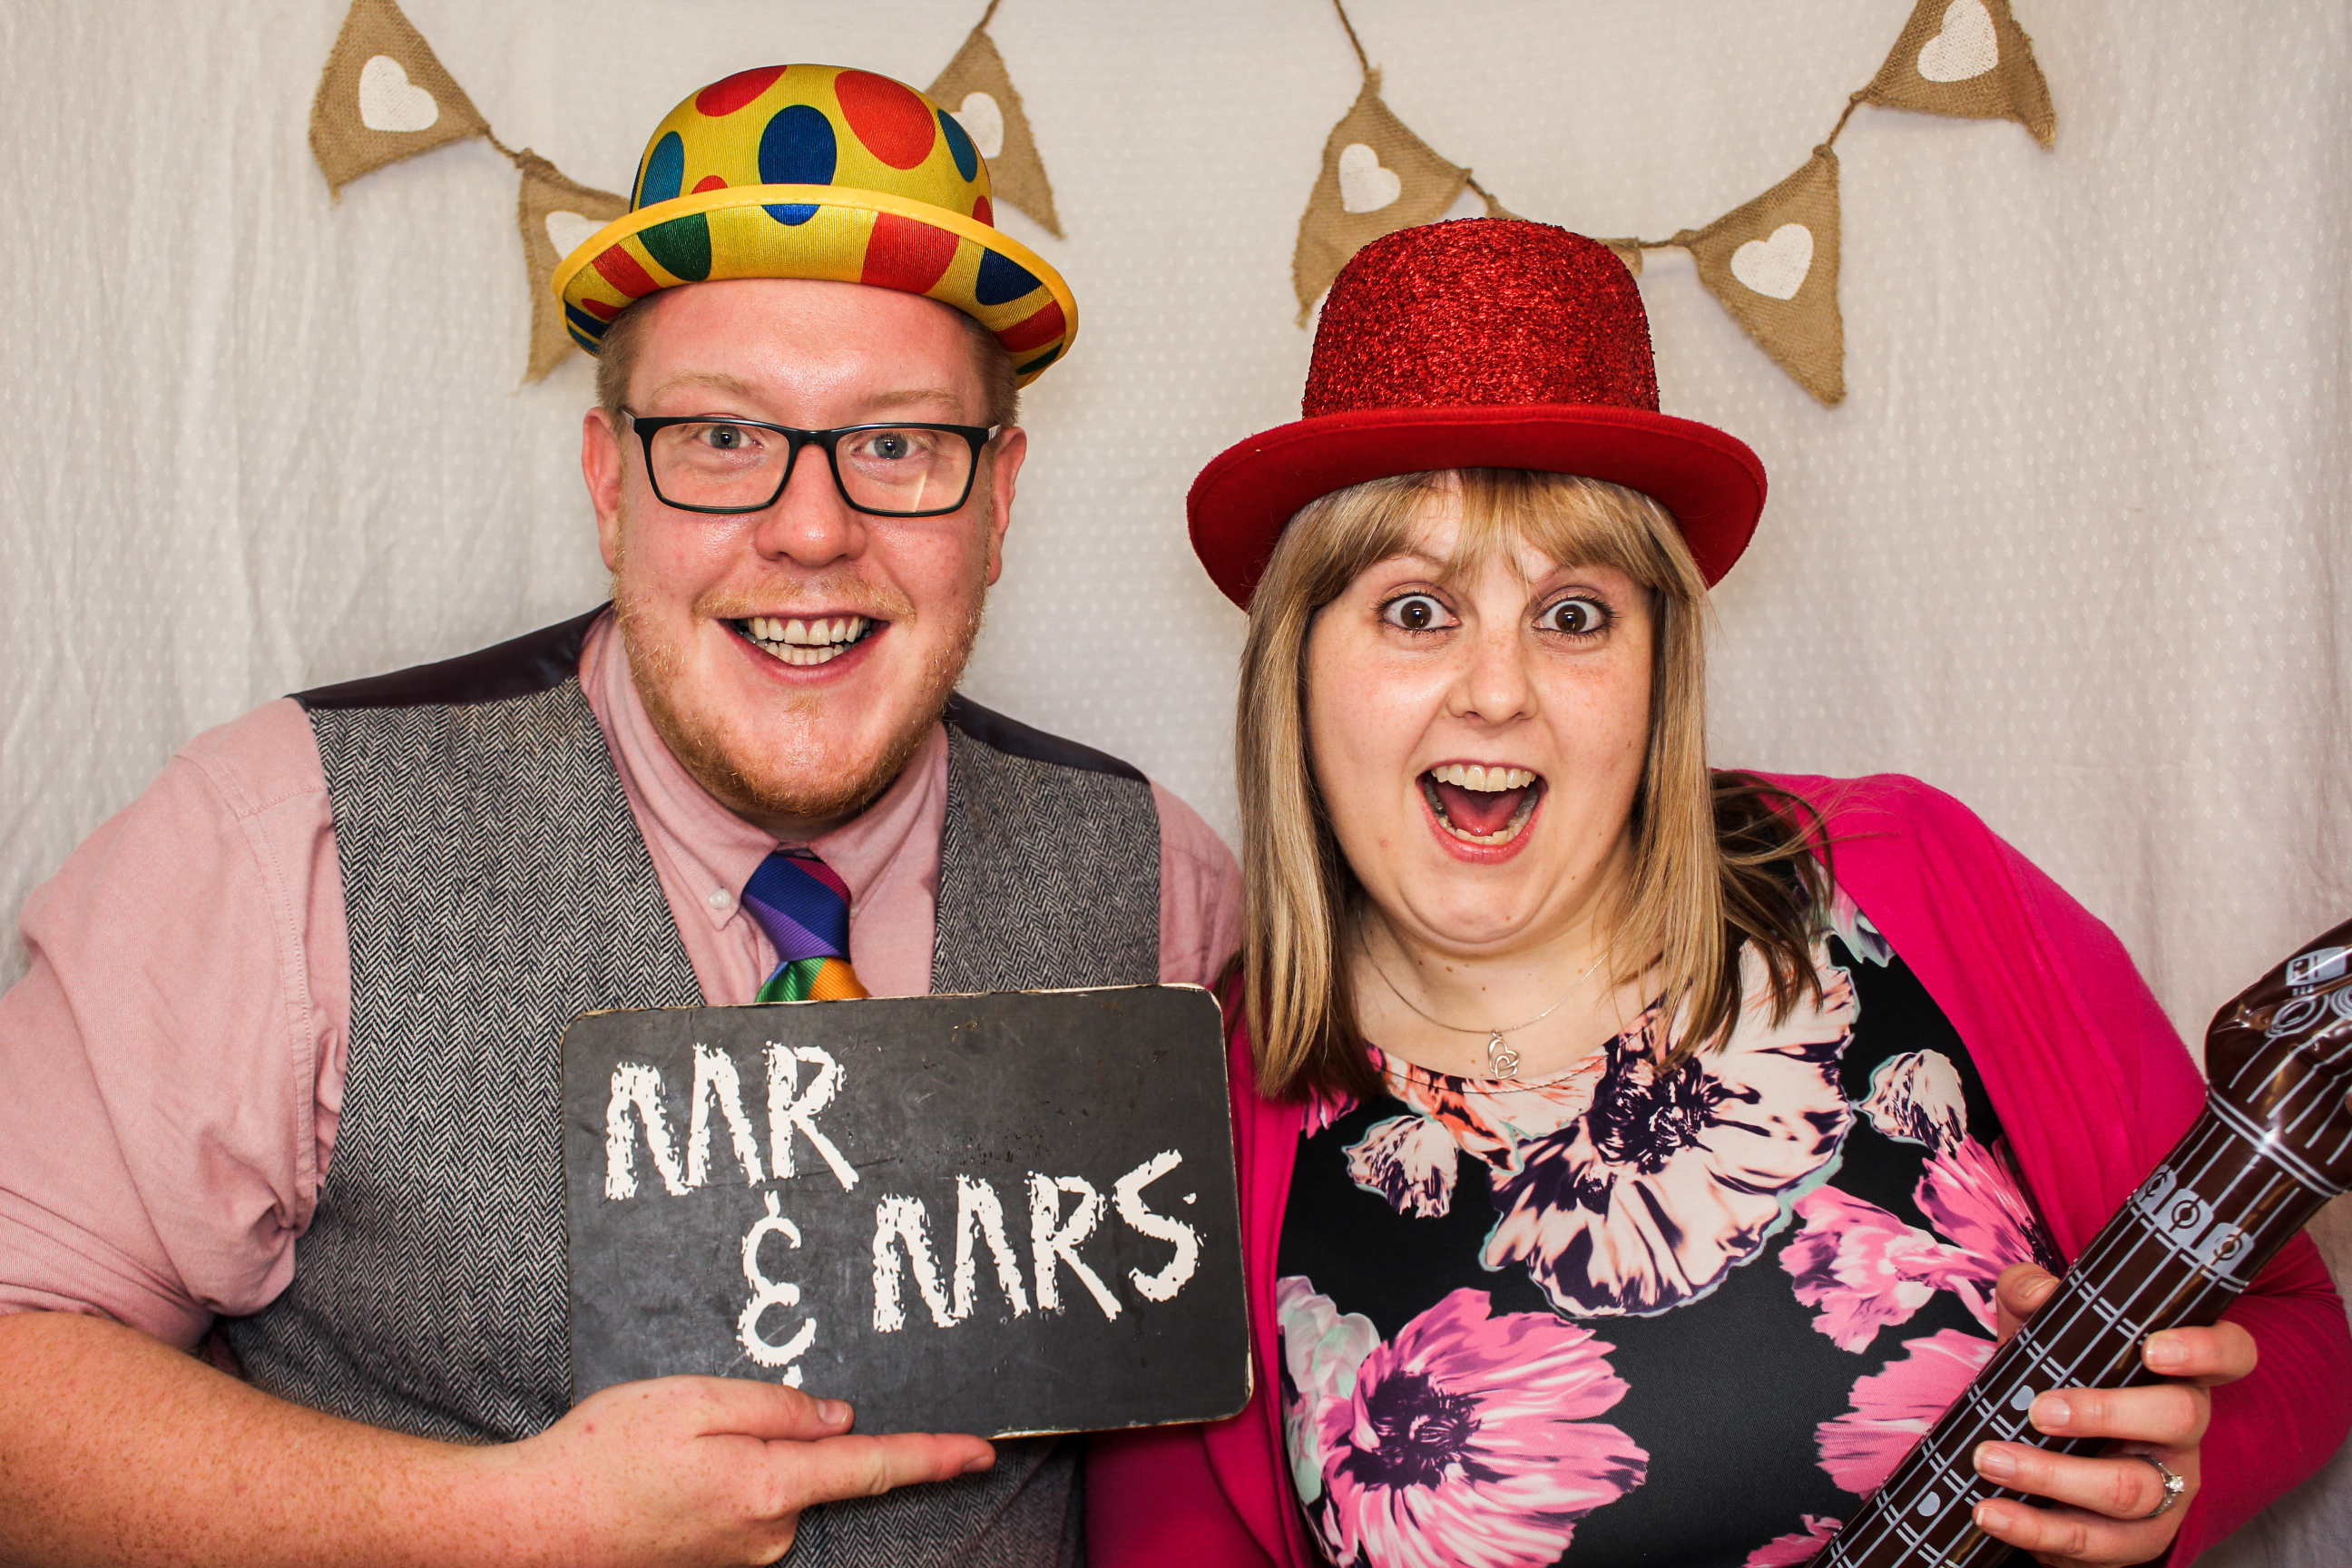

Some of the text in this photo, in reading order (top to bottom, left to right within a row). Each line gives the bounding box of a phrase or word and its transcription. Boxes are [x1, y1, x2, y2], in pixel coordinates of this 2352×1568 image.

[604, 1040, 860, 1201] MR
[735, 1149, 1206, 1390] & MRS
